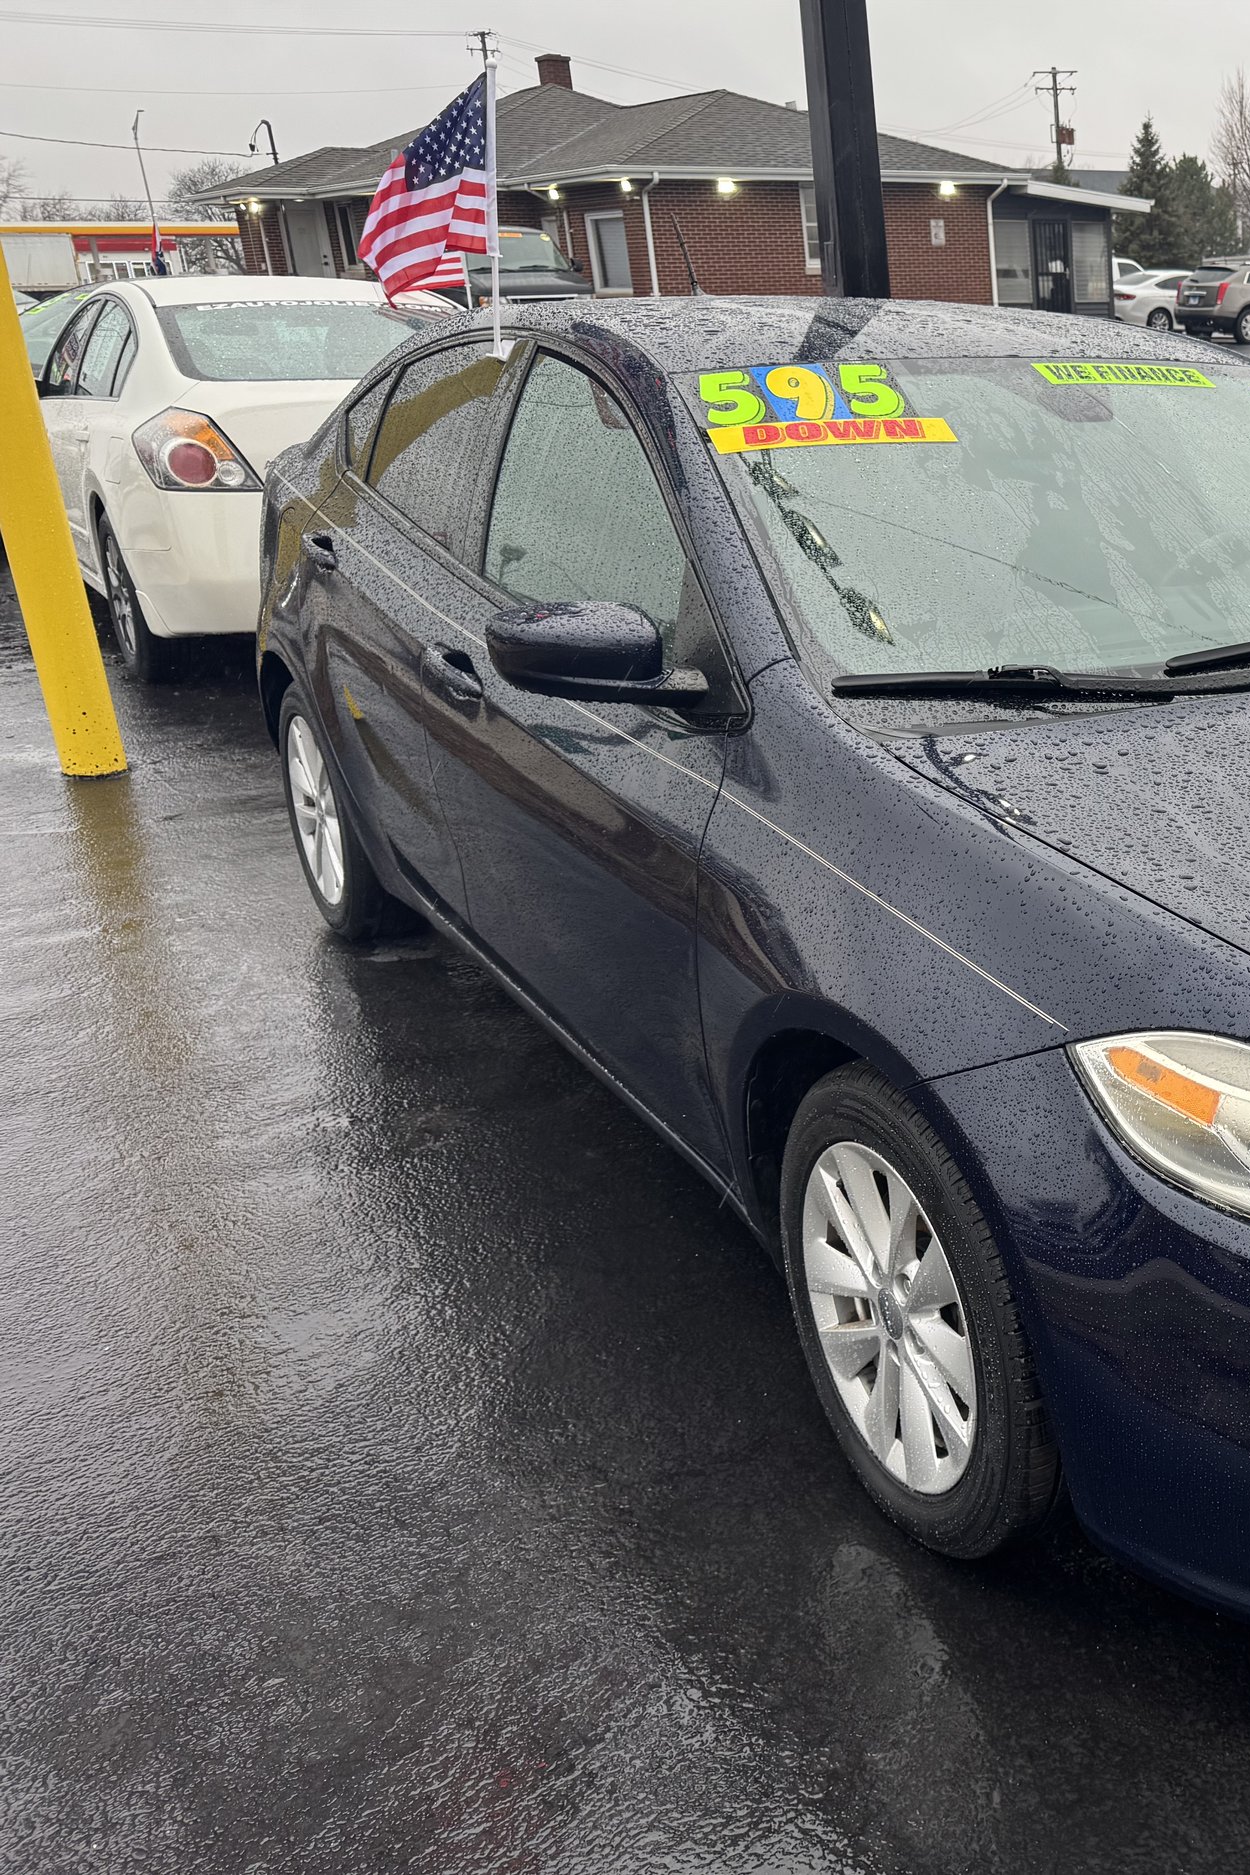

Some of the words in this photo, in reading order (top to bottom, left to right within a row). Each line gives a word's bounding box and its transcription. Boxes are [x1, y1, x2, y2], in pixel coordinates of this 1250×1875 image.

[1044, 364, 1094, 381] WE
[1091, 365, 1202, 385] FINANCE
[699, 364, 906, 427] 595
[743, 419, 926, 446] DOWN
